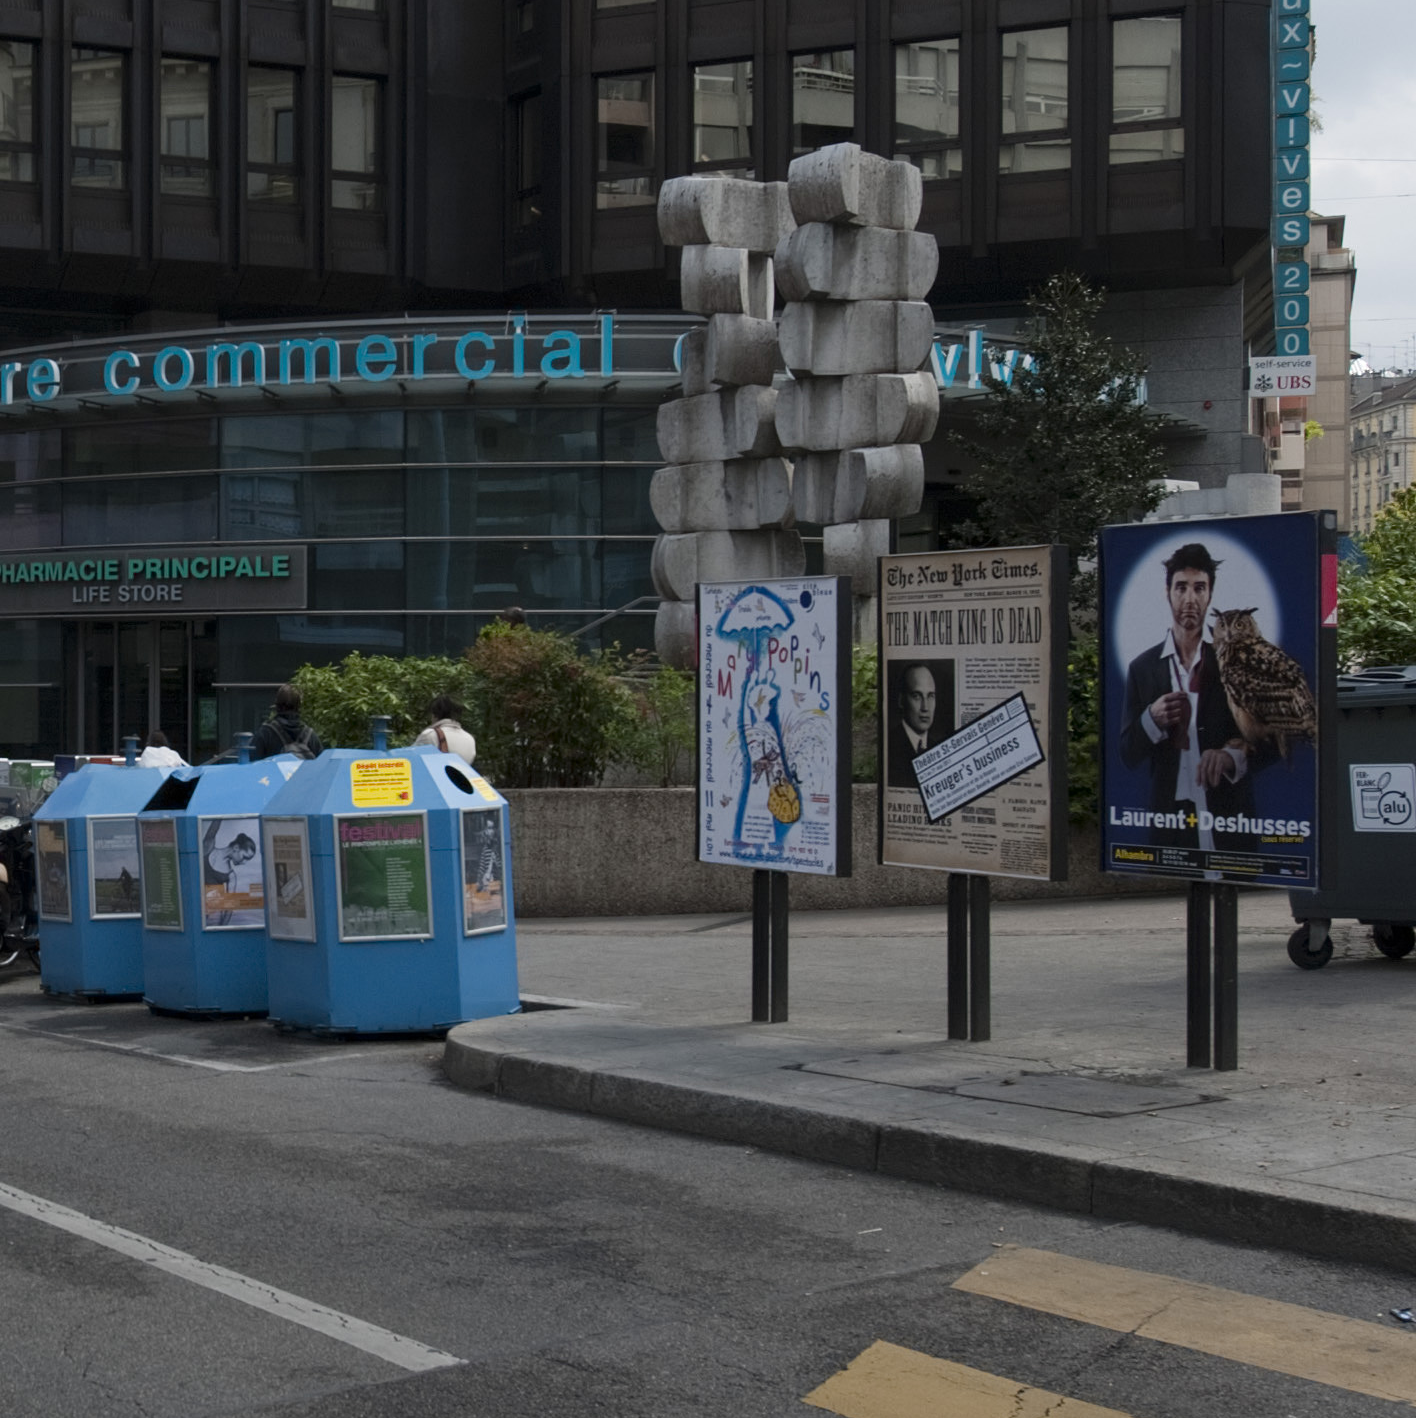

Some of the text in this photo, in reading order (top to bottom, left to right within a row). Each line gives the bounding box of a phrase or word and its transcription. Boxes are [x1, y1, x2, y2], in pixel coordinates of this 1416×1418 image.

[103, 314, 614, 396] commercial
[1255, 358, 1312, 369] self-service
[1277, 374, 1312, 390] UBS
[128, 555, 290, 580] PRINCIPALE
[887, 565, 914, 589] The
[917, 565, 948, 586] New
[952, 561, 987, 587] York
[72, 584, 183, 603] LIFE STORE
[887, 606, 1042, 647] THE MATCH KING IS DEAD
[704, 643, 715, 688] mercredi
[768, 635, 830, 711] Poppins
[704, 737, 715, 783] mercredi
[914, 750, 941, 771] Théâtre
[941, 729, 978, 754] St-Gervais
[924, 763, 974, 800] Kreuger's
[973, 736, 1020, 771] business
[887, 802, 911, 813] PANIC
[887, 813, 923, 825] LEADING
[1384, 800, 1406, 813] alu
[341, 820, 422, 841] festival
[1114, 848, 1154, 862] Alhambra
